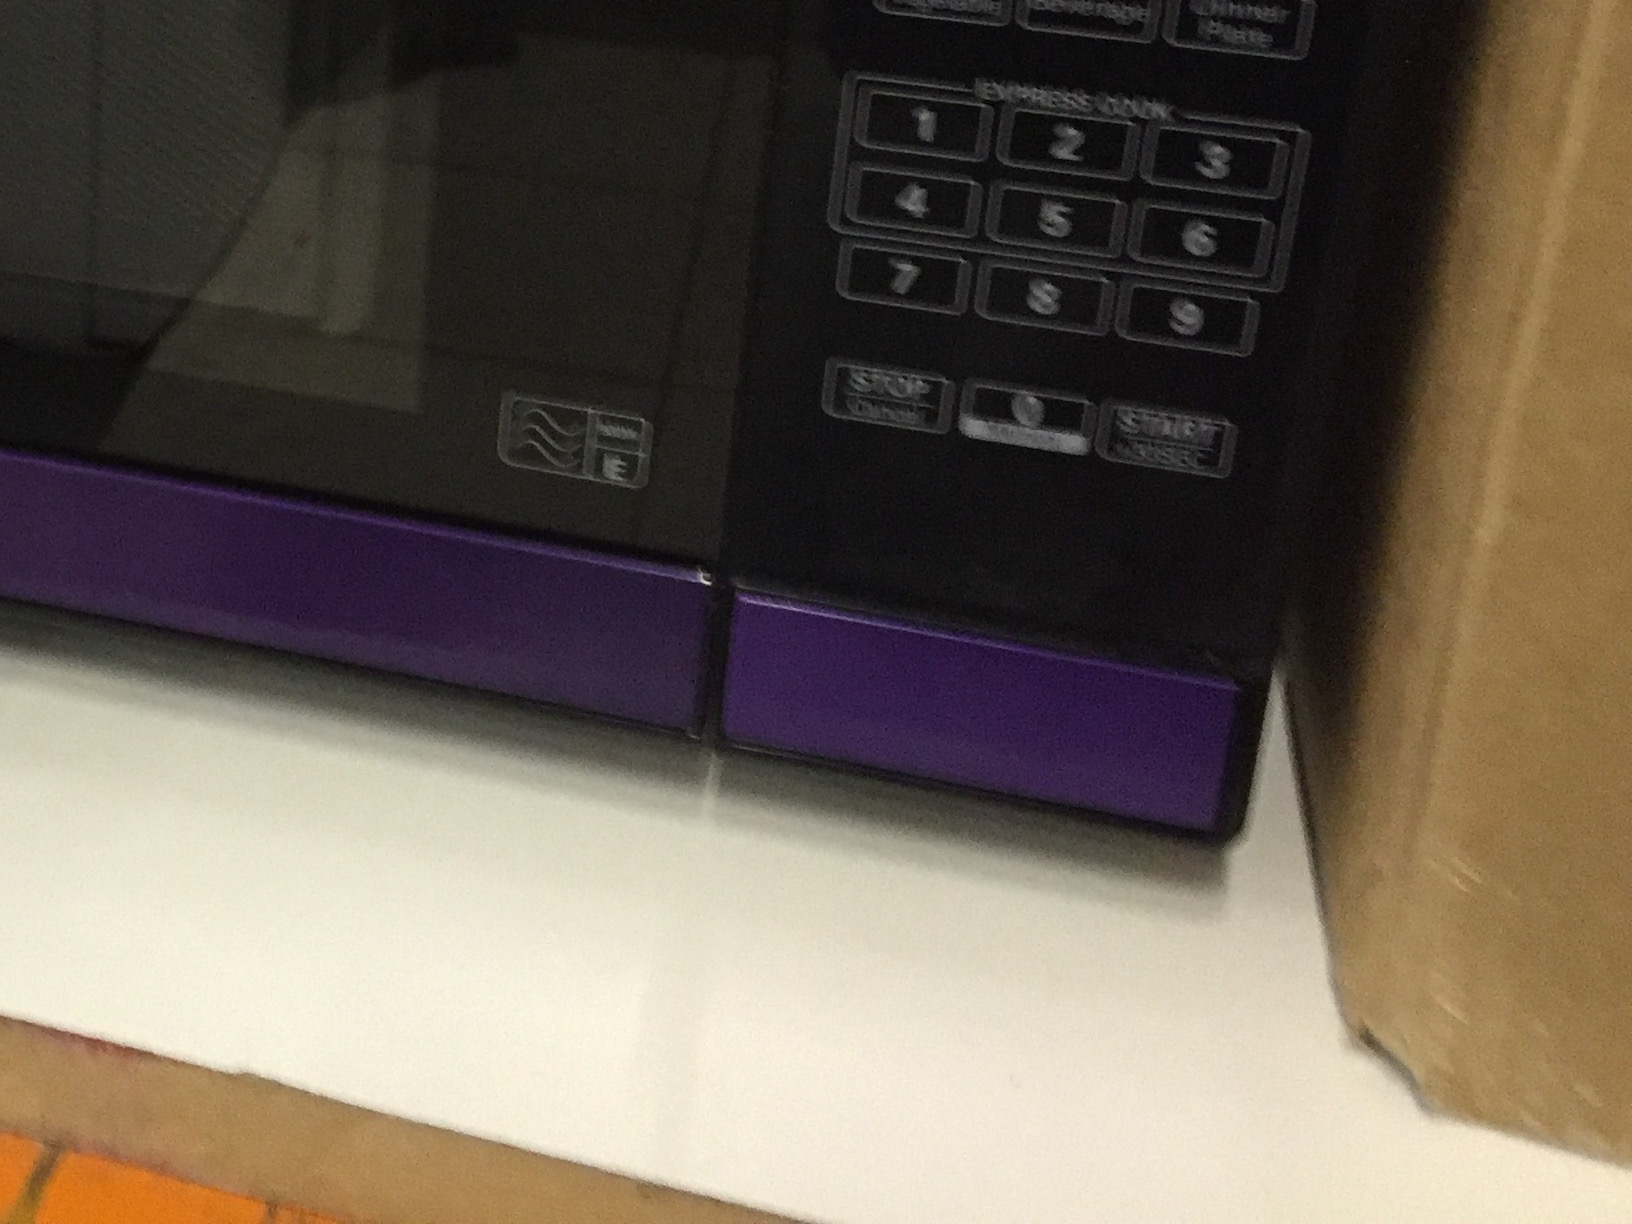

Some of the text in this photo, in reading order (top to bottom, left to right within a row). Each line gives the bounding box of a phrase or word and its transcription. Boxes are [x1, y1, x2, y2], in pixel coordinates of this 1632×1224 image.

[911, 106, 937, 143] 1
[1049, 122, 1086, 162] 2
[1195, 139, 1232, 179] 3
[895, 183, 930, 219] 4
[1037, 199, 1073, 239] 5
[1181, 218, 1218, 258] 6
[889, 258, 921, 295] 7
[1026, 277, 1063, 316] 8
[1169, 296, 1205, 336] 9
